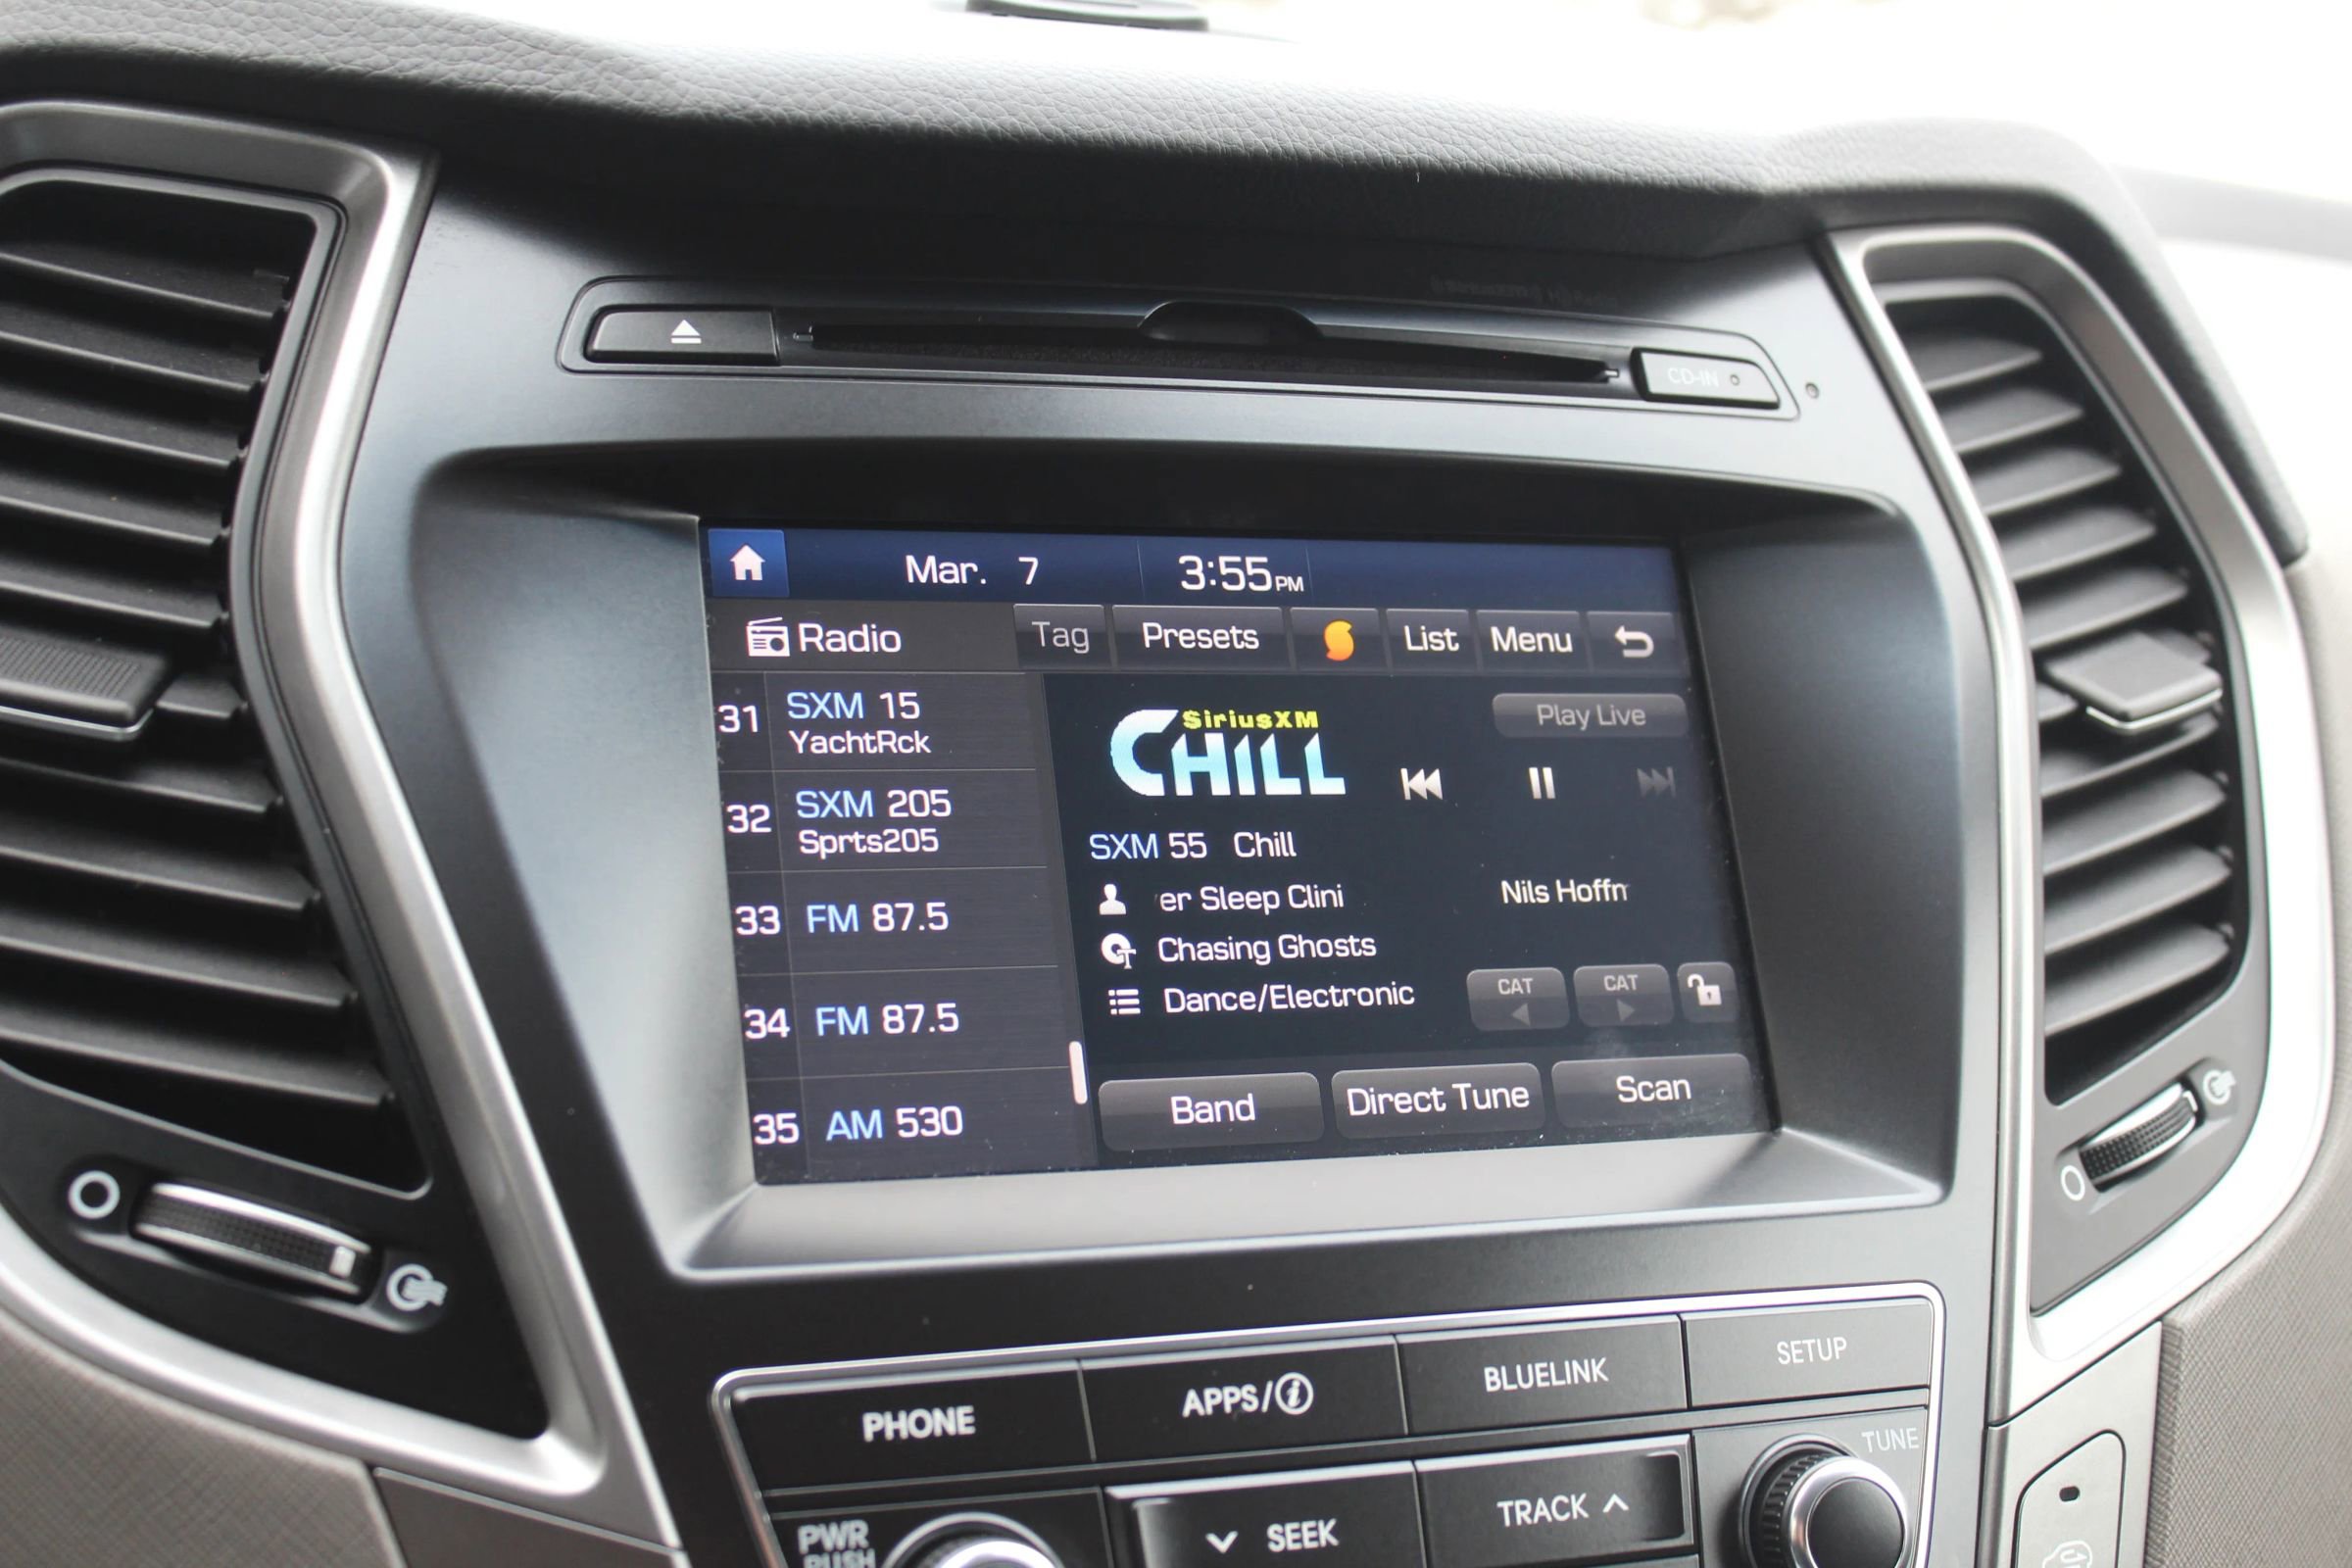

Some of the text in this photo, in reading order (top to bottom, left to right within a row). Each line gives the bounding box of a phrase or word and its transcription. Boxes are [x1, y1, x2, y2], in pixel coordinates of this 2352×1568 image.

[1668, 367, 1720, 387] CD-IN
[906, 555, 1039, 585] Mar. 7
[798, 622, 902, 653] Radio
[1031, 621, 1090, 654] Tag
[1142, 621, 1260, 650] Presets
[1403, 624, 1460, 652] List
[1491, 626, 1574, 654] Menu
[718, 705, 760, 733] 31
[787, 692, 921, 719] SXM 15
[1182, 710, 1320, 730] SiriusXM
[1536, 704, 1646, 731] Play Live
[789, 729, 932, 754] YachtRck
[1109, 709, 1347, 797] CHILL
[796, 789, 953, 818] SXM 205
[726, 805, 772, 833] 32
[799, 828, 940, 858] Sprts205
[1089, 831, 1298, 860] SXM 55 Chill
[1200, 885, 1281, 915] Sleep
[1287, 883, 1345, 909] Clini
[1500, 879, 1550, 904] Nils
[735, 905, 781, 935] 33
[807, 902, 950, 933] FM 87.5
[1157, 934, 1377, 965] Chasing Ghosts
[1164, 981, 1415, 1013] Dance/Electronic
[1497, 978, 1534, 996] CAT
[1603, 974, 1640, 992] CAT
[743, 1007, 790, 1039] 34
[815, 1003, 960, 1036] FM 87.5
[1347, 1083, 1530, 1117] Direct Tune
[1615, 1075, 1692, 1103] Scan
[825, 1105, 963, 1141] AM 530
[1170, 1093, 1256, 1124] Band
[753, 1112, 800, 1145] 35
[1776, 1337, 1848, 1366] SETUP
[1483, 1357, 1610, 1393] BLUELINK
[861, 1405, 976, 1443] PHONE
[1861, 1427, 1920, 1454] TUNE
[1496, 1493, 1590, 1528] TRACK
[798, 1519, 869, 1555] PWR
[1266, 1518, 1340, 1553] SEEK
